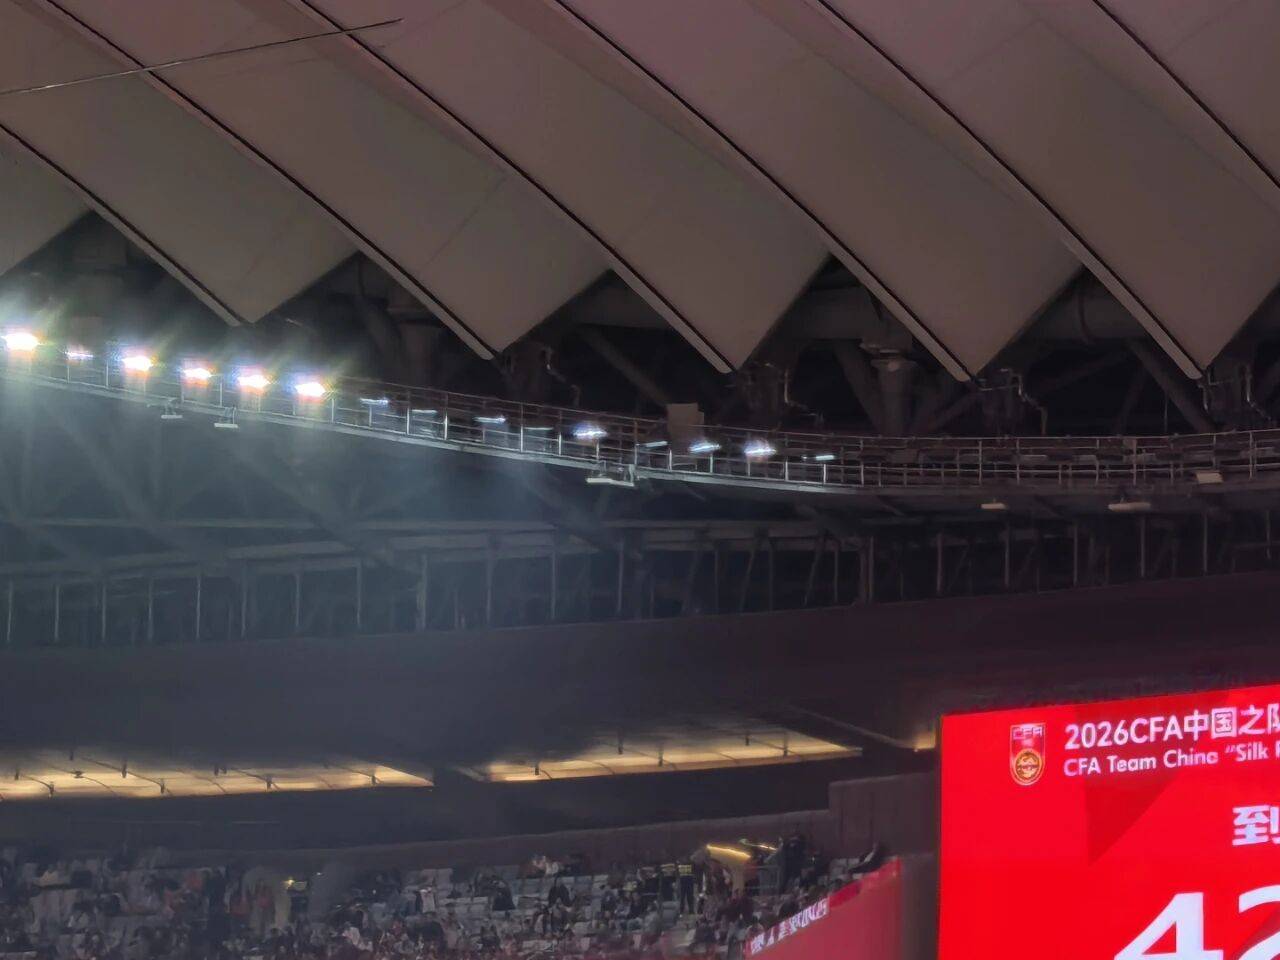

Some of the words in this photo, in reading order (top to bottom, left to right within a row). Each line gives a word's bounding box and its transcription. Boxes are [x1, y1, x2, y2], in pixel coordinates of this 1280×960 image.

[1065, 757, 1100, 776] CFA
[1107, 755, 1156, 772] Team
[1164, 749, 1217, 767] China
